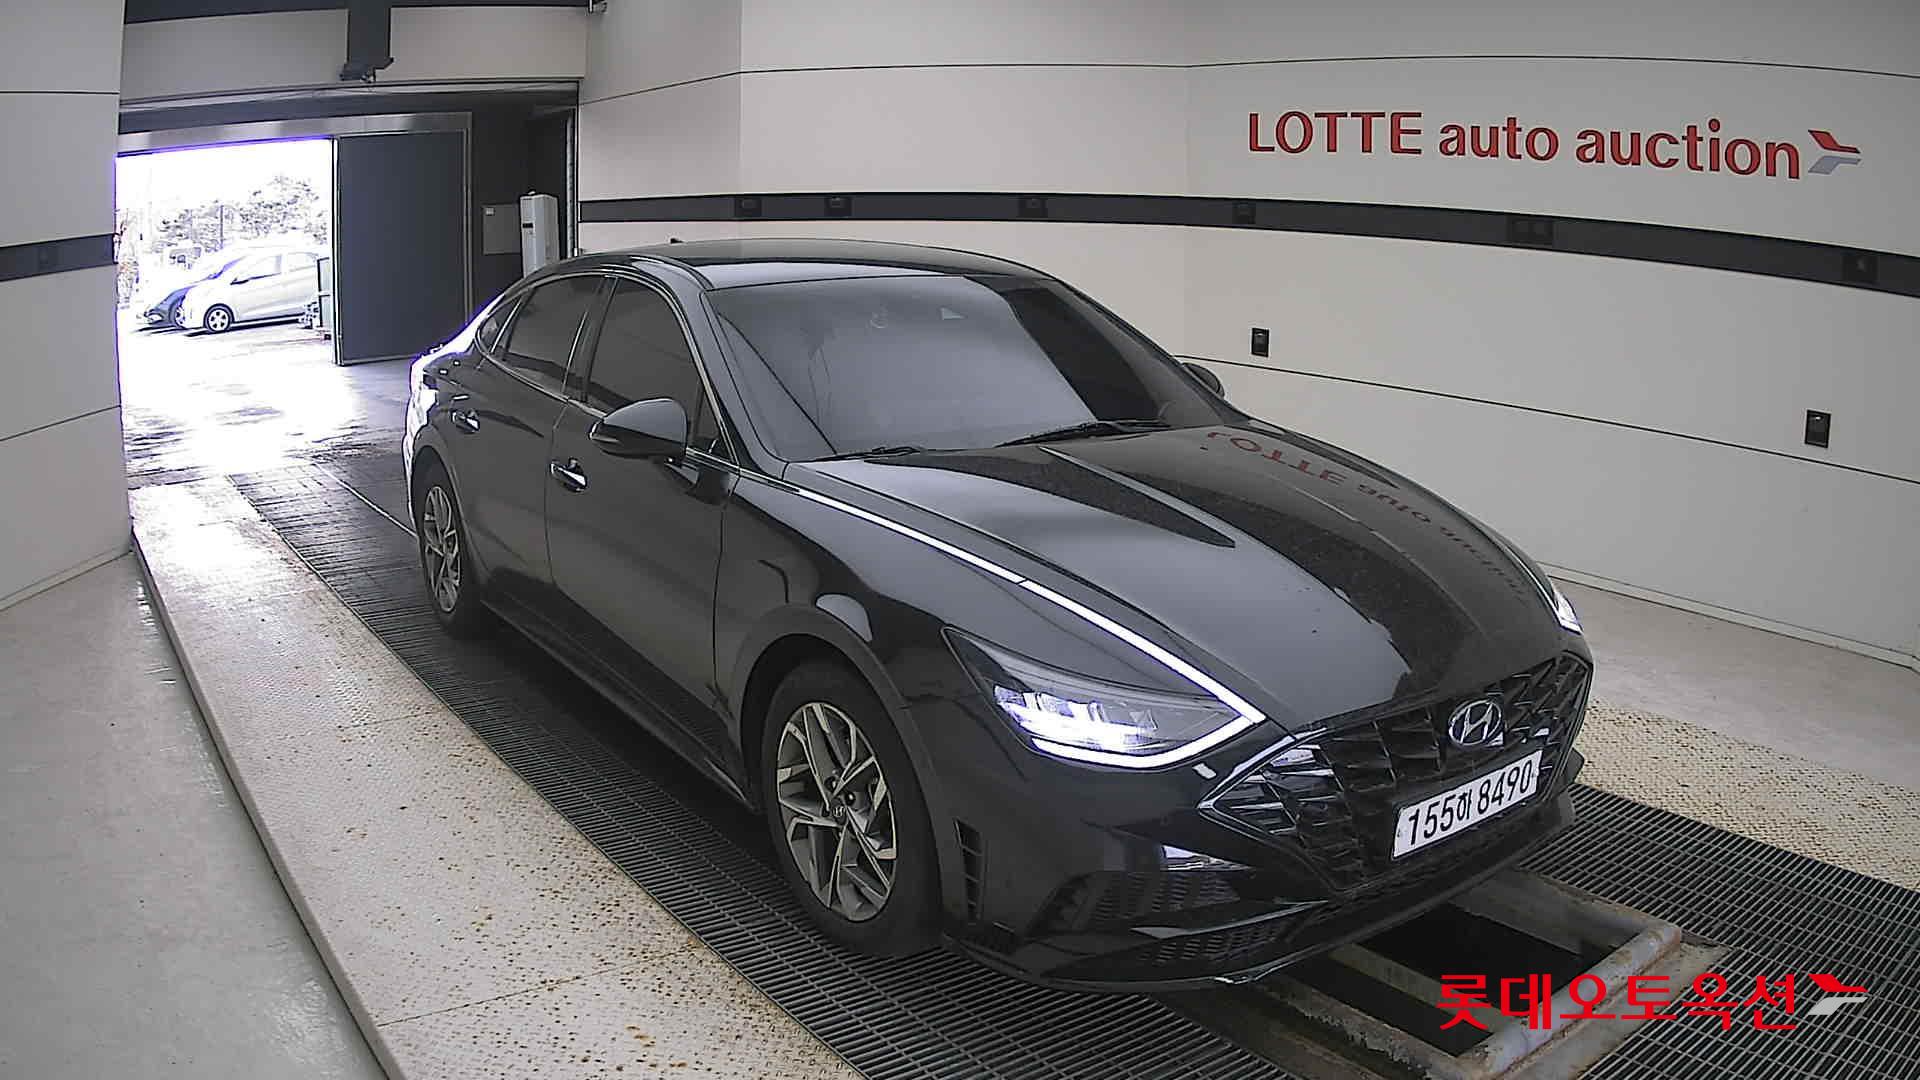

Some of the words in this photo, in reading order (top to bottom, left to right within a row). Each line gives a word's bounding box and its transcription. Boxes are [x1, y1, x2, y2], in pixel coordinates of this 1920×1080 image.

[1248, 111, 1423, 155] LOTTE
[1438, 116, 1560, 162] auto
[1575, 118, 1801, 181] auction
[1408, 789, 1473, 845] 155하
[1477, 759, 1533, 815] 8490
